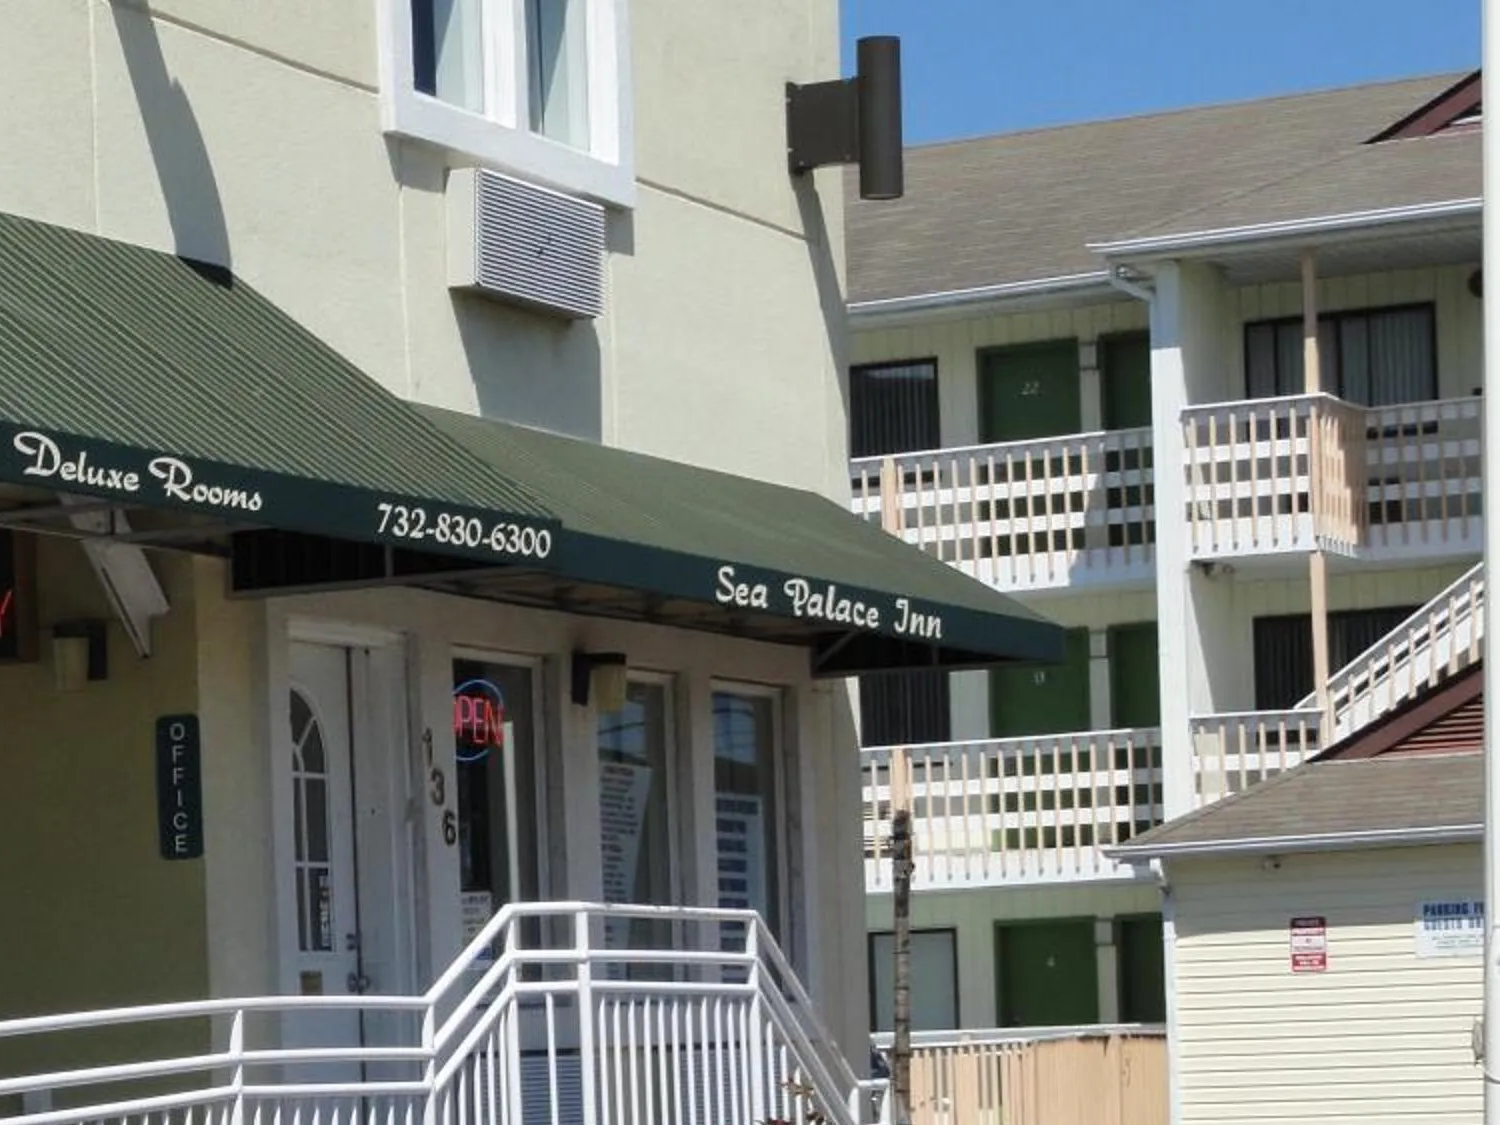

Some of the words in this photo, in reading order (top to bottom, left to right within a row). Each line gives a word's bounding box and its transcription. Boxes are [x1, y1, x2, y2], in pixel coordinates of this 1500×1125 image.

[12, 430, 141, 493] Deluxe
[147, 456, 263, 513] Rooms
[377, 502, 552, 559] 732-830-6300
[714, 565, 769, 610] Sea
[782, 577, 881, 630] Palace
[893, 597, 942, 640] Inn
[169, 722, 189, 854] OFFICE
[421, 726, 457, 846] 136
